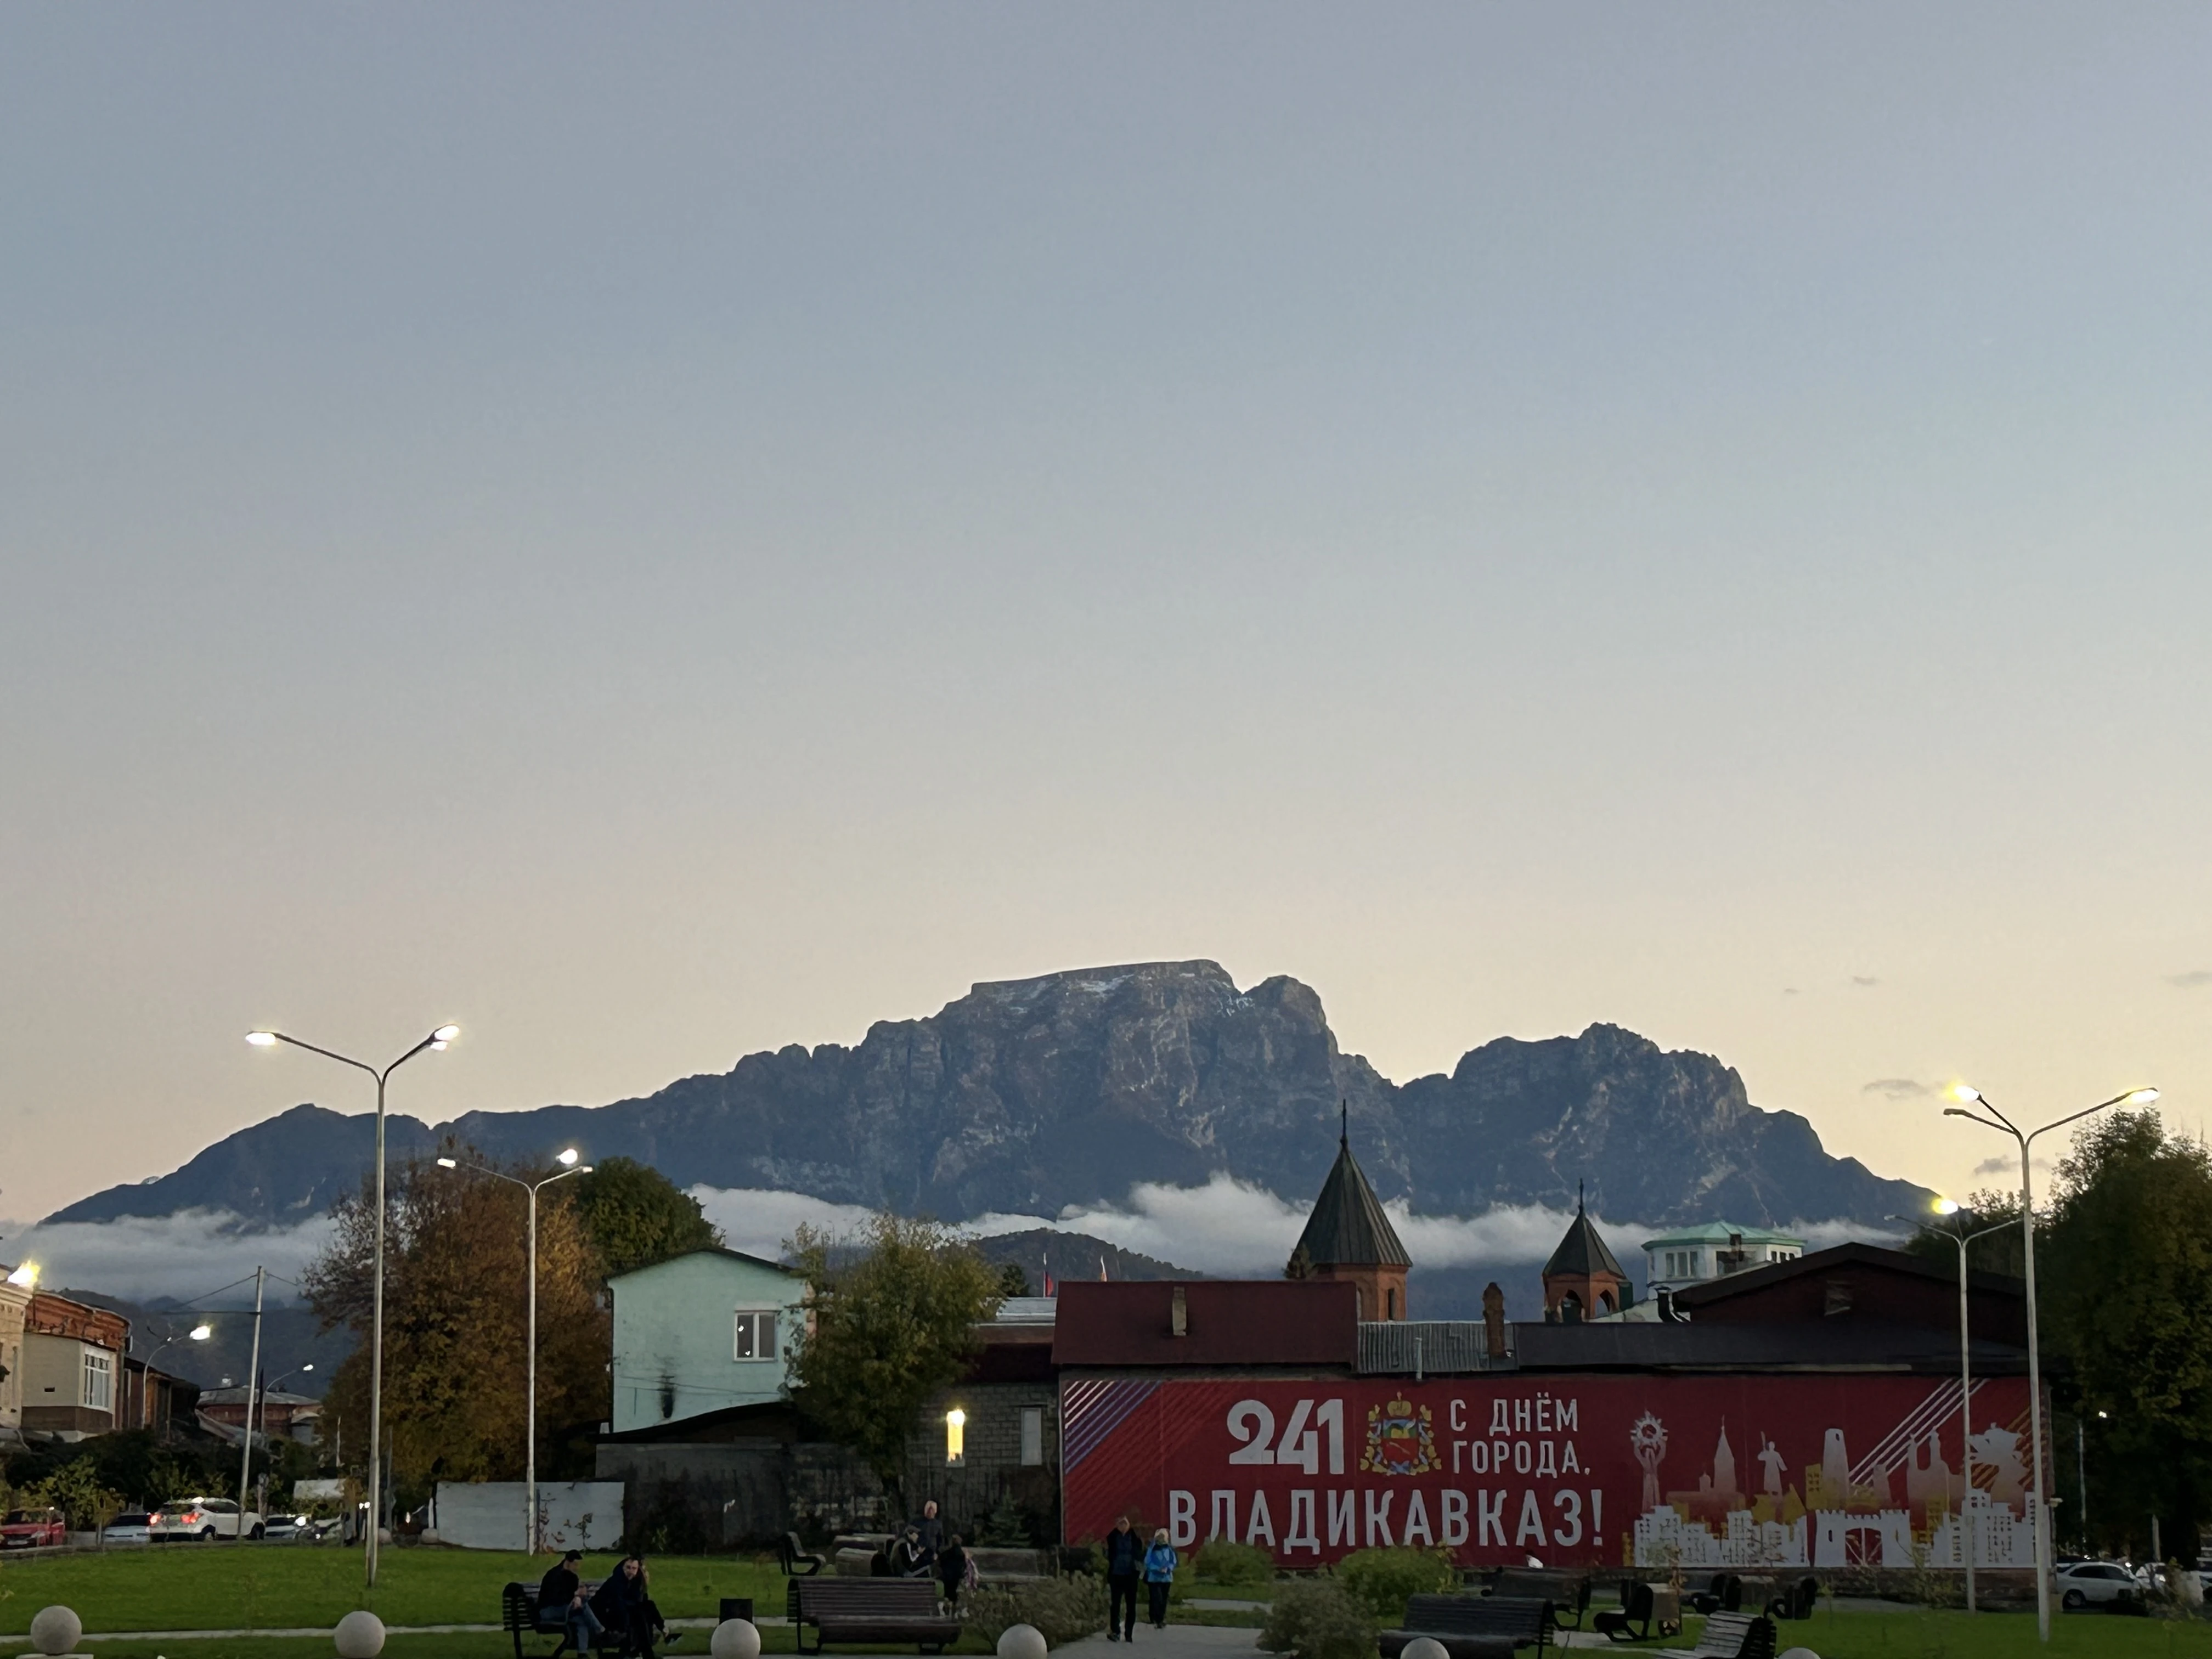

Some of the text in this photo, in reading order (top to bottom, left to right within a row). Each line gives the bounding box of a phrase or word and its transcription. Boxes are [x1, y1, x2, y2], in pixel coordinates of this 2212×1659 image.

[1227, 1398, 1345, 1475] 241
[1450, 1392, 1578, 1436] С ДНЁМ
[1169, 1489, 1602, 1555] ВЛАДИКАВКАЗ!
